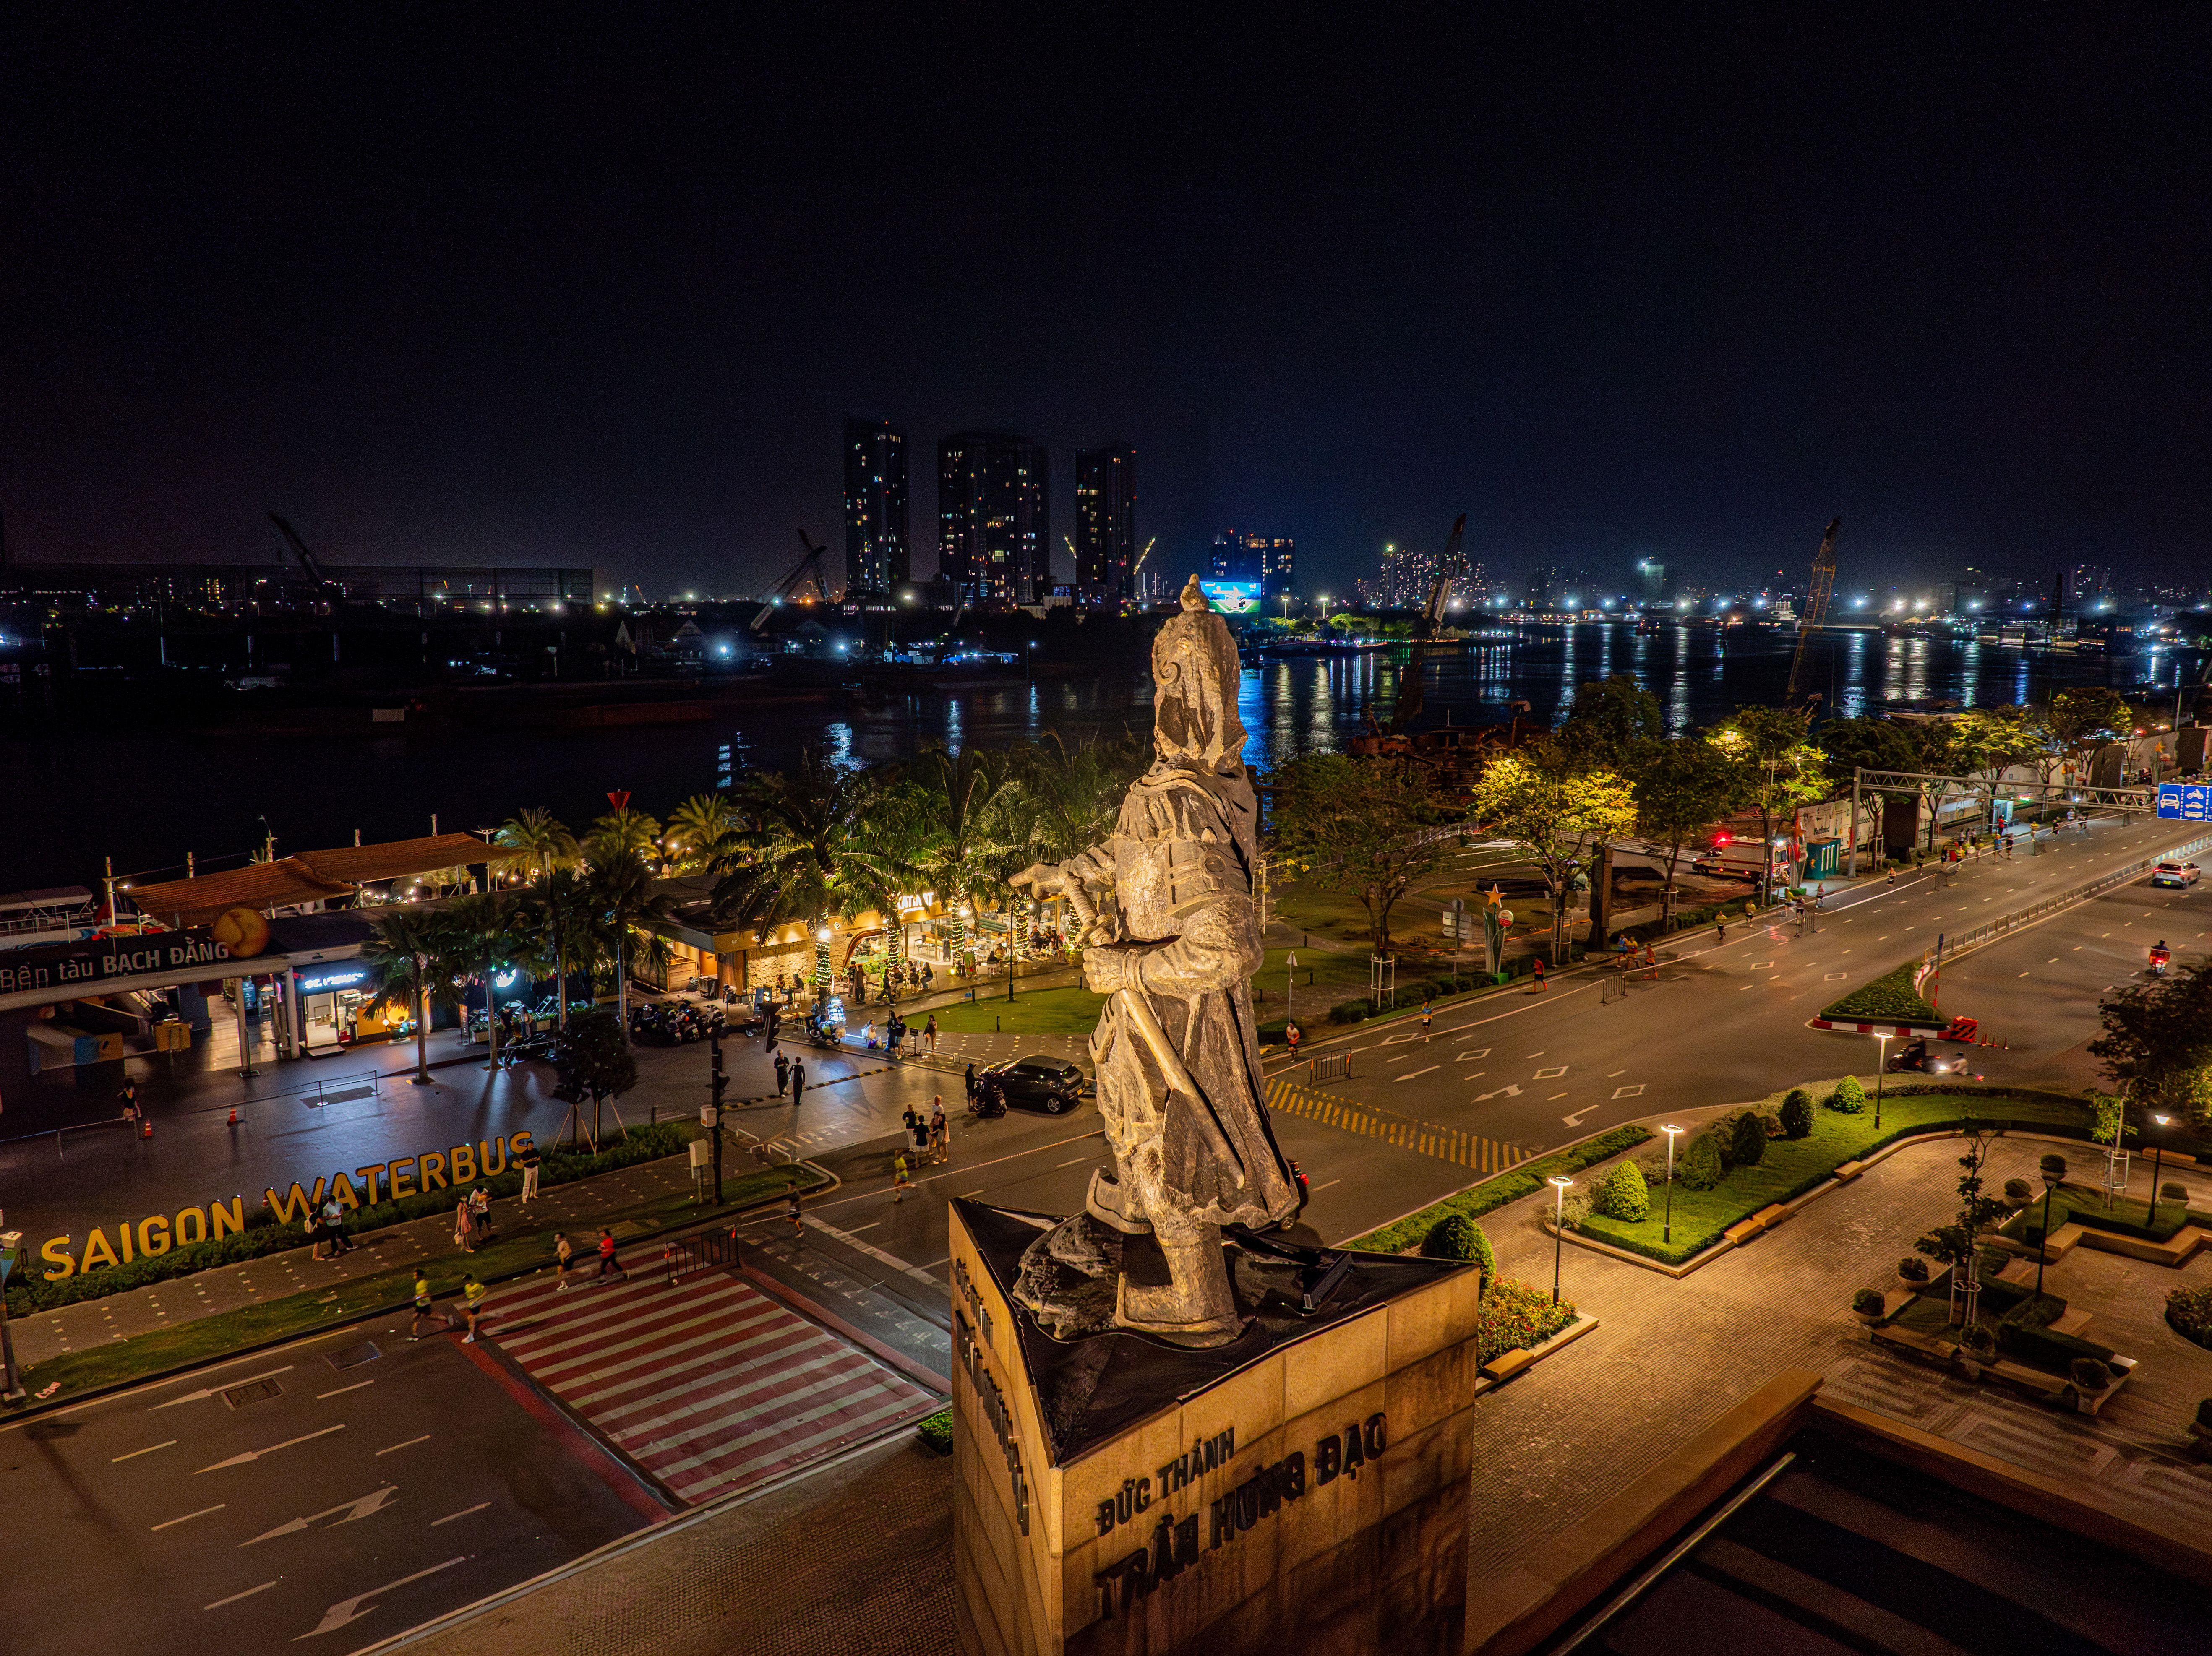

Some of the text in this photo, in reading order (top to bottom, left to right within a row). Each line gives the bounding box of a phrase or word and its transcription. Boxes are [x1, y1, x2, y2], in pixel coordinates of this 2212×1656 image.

[60, 960, 93, 980] tàu
[102, 949, 160, 976] BẠCH
[41, 1131, 532, 1281] SAIGON WATERBUS
[1095, 1426, 1235, 1537] ĐỨC THÁNH
[1314, 1412, 1387, 1486] ĐẠO
